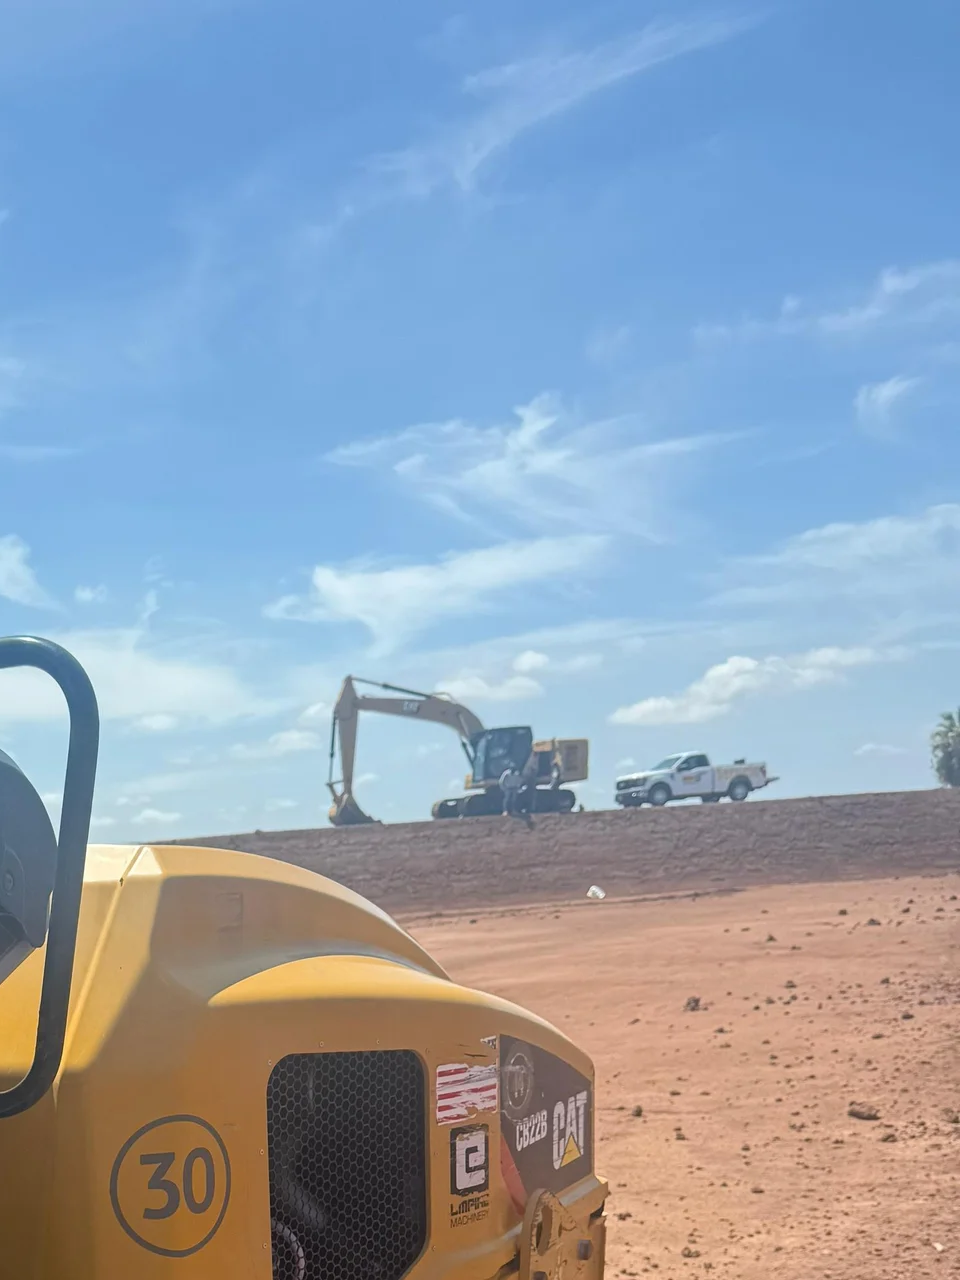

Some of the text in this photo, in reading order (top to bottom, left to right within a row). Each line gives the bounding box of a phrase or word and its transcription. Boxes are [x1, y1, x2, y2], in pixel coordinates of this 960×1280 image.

[515, 1109, 548, 1152] CB22B
[552, 1090, 588, 1170] CAT
[139, 1147, 216, 1220] 30
[450, 1209, 489, 1228] MACHINERY
